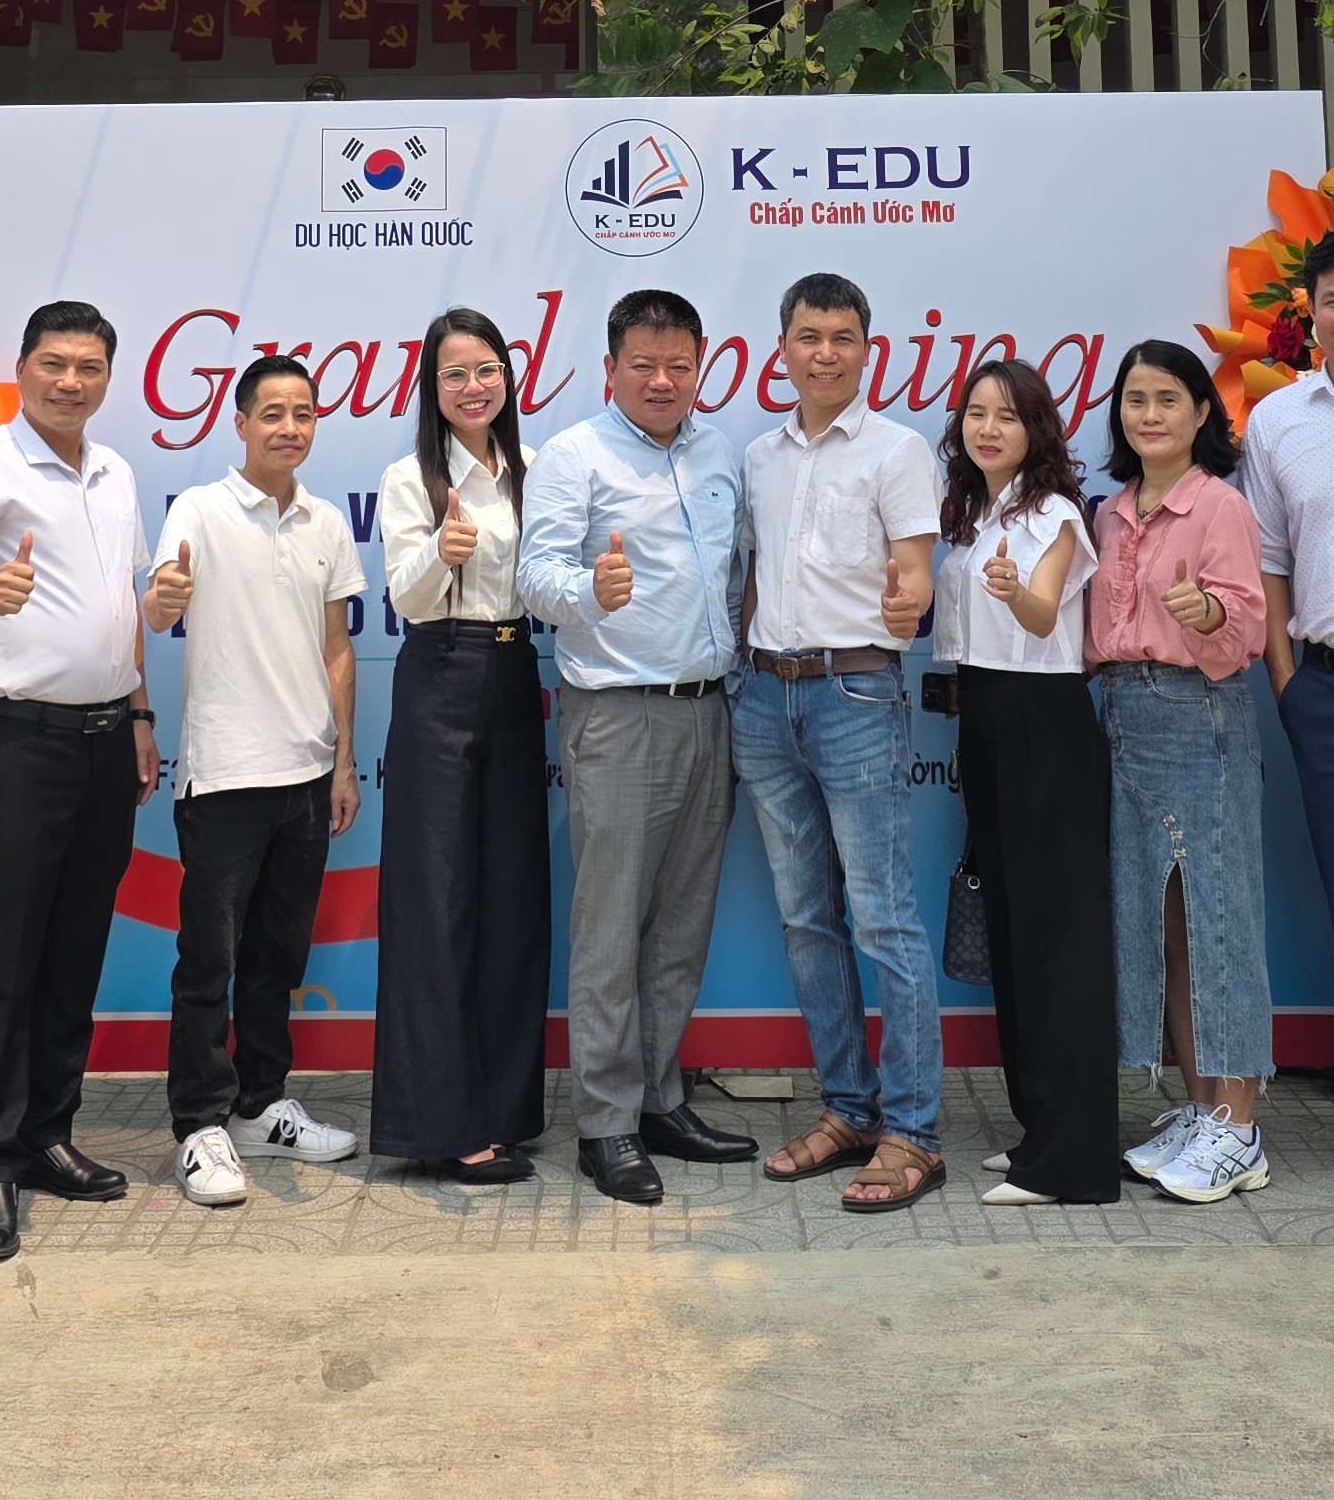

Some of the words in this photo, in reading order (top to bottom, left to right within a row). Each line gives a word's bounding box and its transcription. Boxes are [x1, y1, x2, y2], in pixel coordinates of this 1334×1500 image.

[731, 147, 778, 191] K
[825, 145, 971, 191] EDU
[595, 214, 610, 229] K
[629, 213, 676, 228] EDU
[749, 197, 804, 228] Chấp
[811, 201, 866, 224] Cánh
[872, 198, 914, 224] Ước
[921, 200, 956, 223] Mơ
[295, 222, 321, 248] DU
[328, 222, 367, 251] HỌC
[375, 219, 413, 247] HÀN
[421, 217, 474, 247] QUỐC
